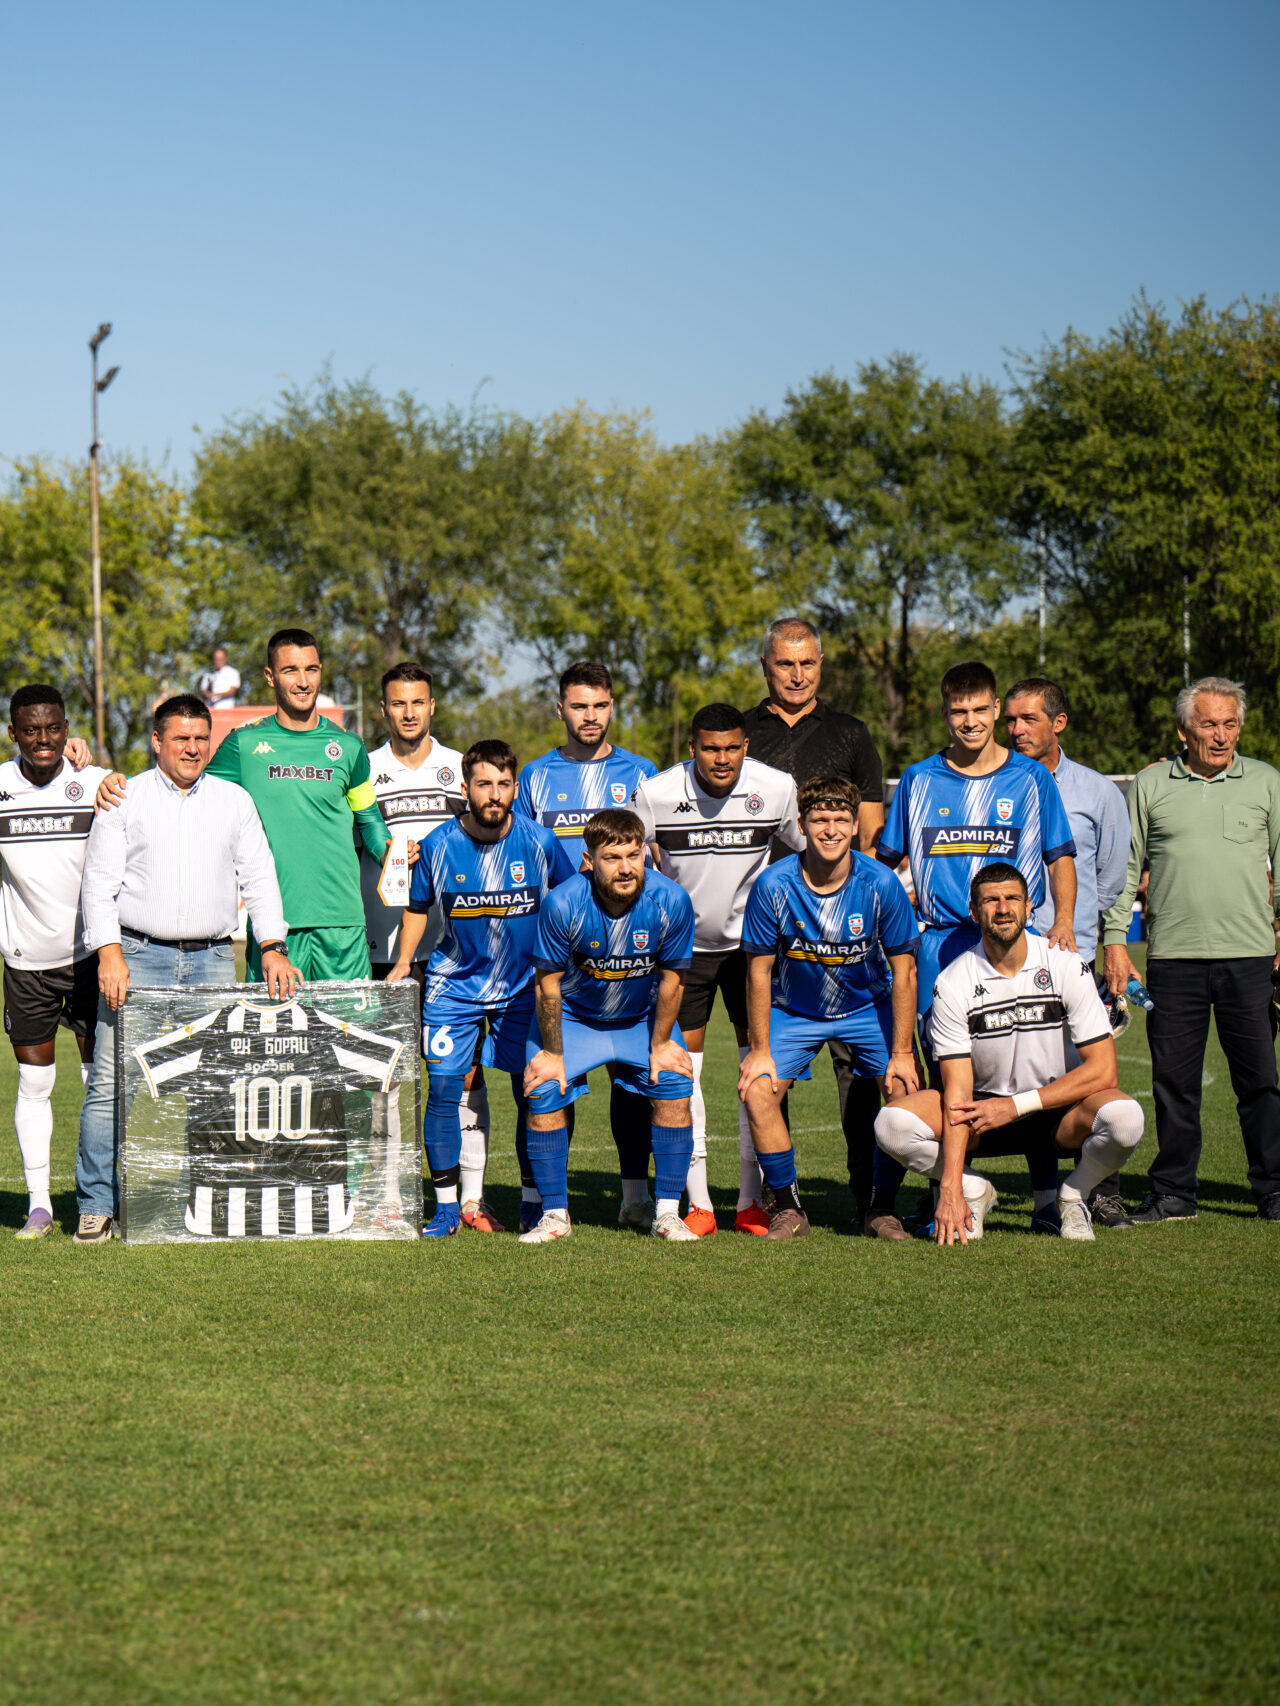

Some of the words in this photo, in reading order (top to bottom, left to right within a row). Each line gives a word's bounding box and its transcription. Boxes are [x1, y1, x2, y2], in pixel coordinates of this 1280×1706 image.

[268, 765, 334, 782] MAXBET
[384, 796, 447, 815] MAXBET
[9, 816, 74, 834] MAXBET
[688, 829, 754, 847] MAXBET
[934, 829, 1015, 844] ADMIRAL
[988, 843, 1014, 854] BET
[453, 891, 535, 908] ADMIRAL
[506, 903, 535, 916] BET
[230, 1037, 251, 1055] ФК
[264, 1036, 309, 1055] БОРАЦ
[423, 1024, 454, 1057] 16
[229, 1075, 312, 1141] 100
